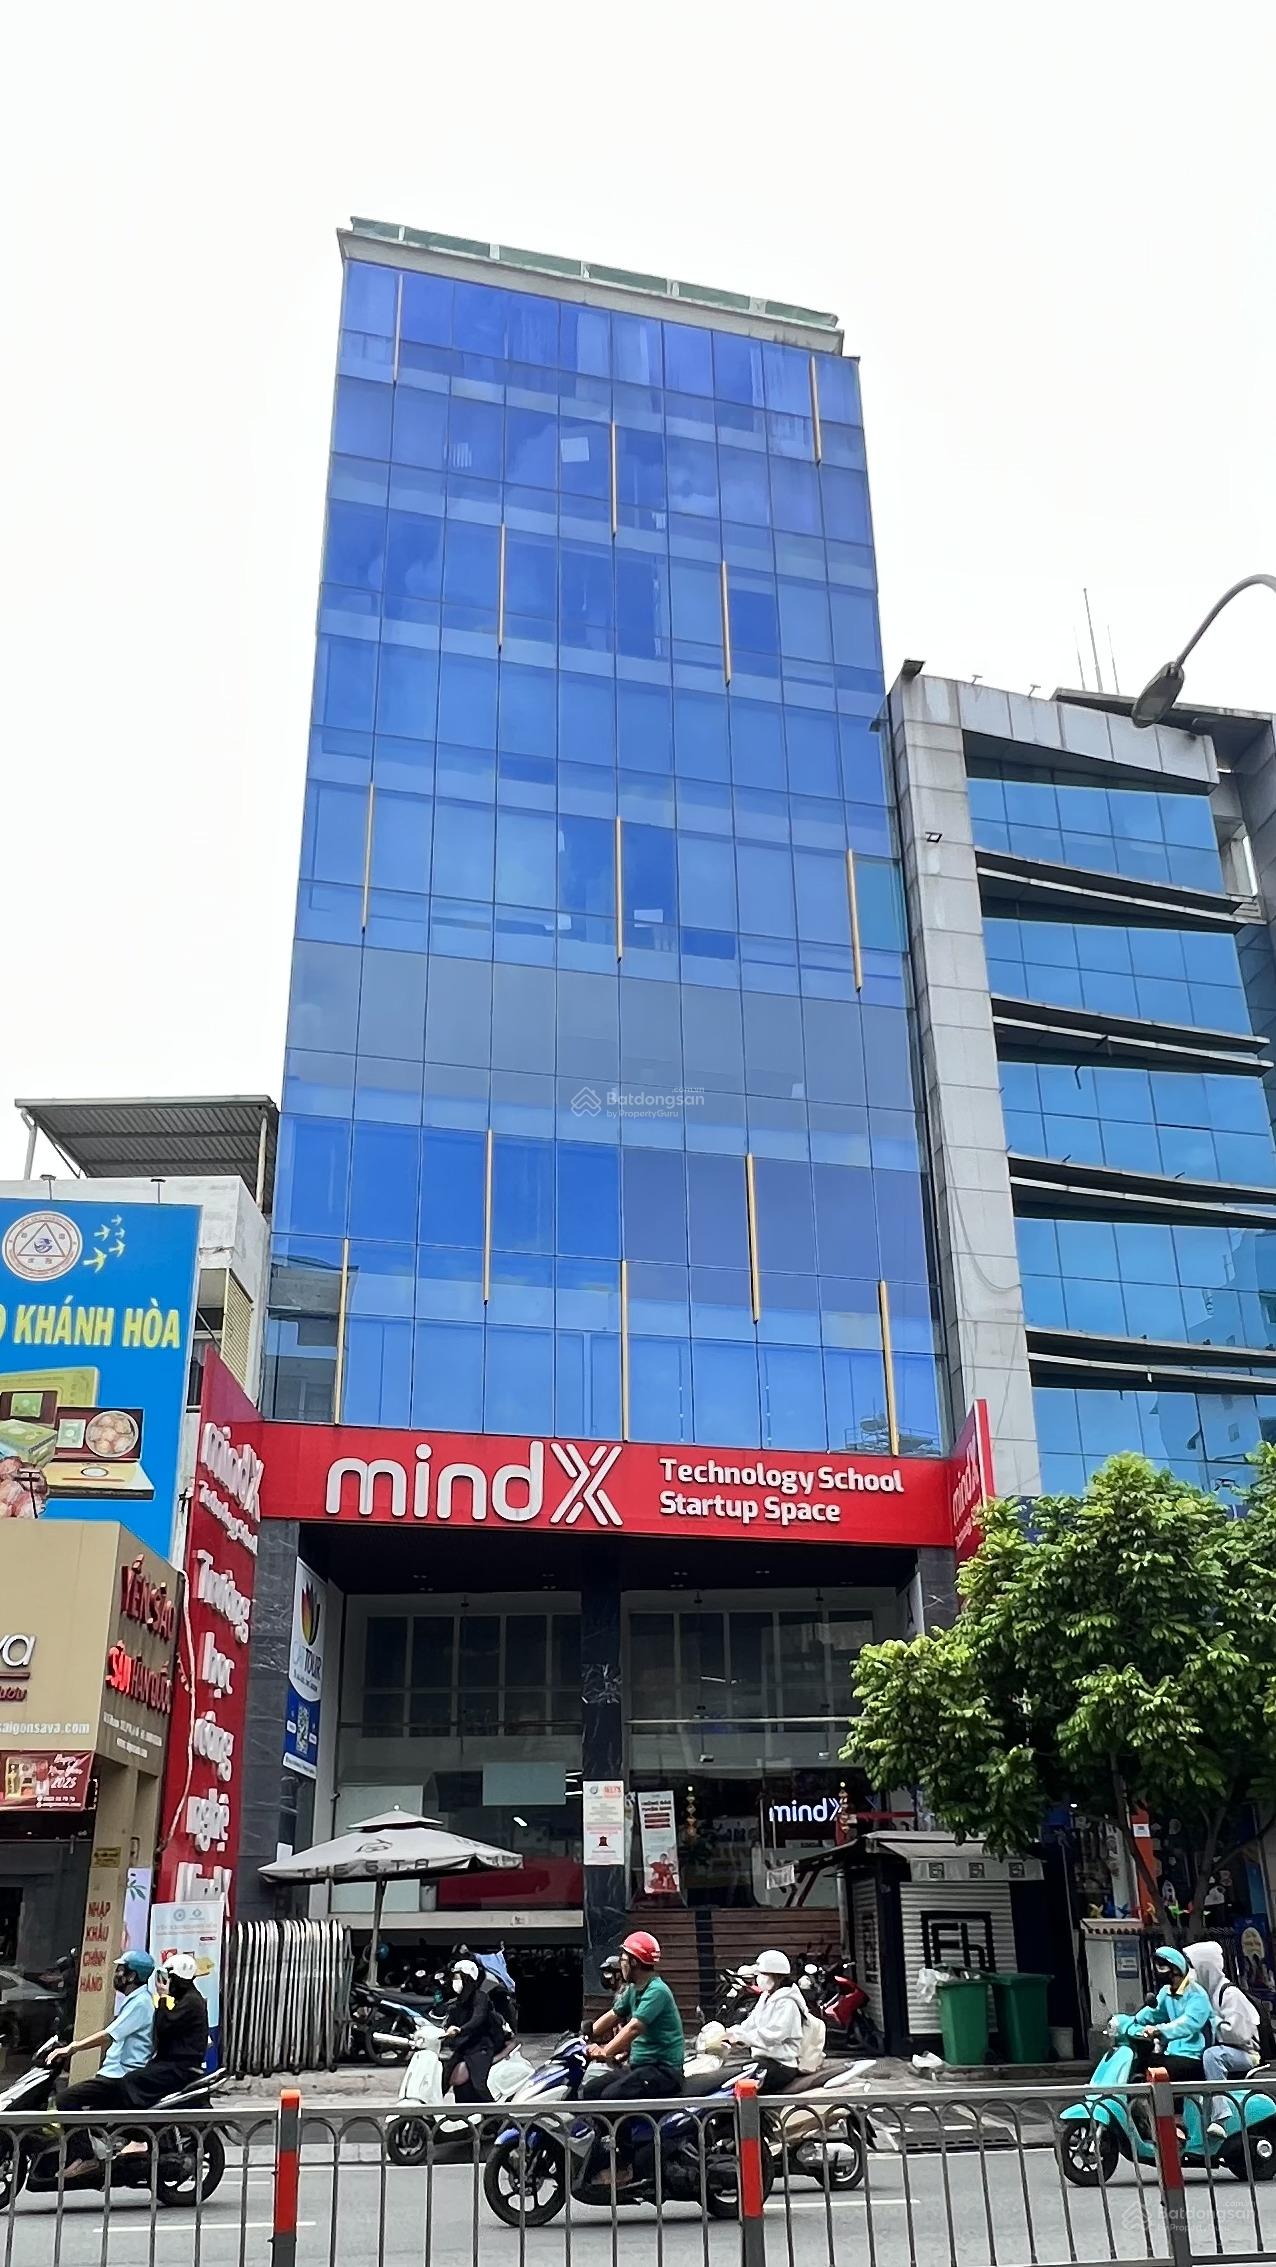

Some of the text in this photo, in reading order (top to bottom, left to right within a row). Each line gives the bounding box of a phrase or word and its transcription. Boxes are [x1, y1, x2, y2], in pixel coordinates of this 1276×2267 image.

[13, 1295, 115, 1346] KHÁNH
[122, 1297, 181, 1348] HÒA
[325, 1440, 624, 1526] mindX
[659, 1458, 905, 1495] Technology School
[659, 1490, 841, 1525] Startup Space
